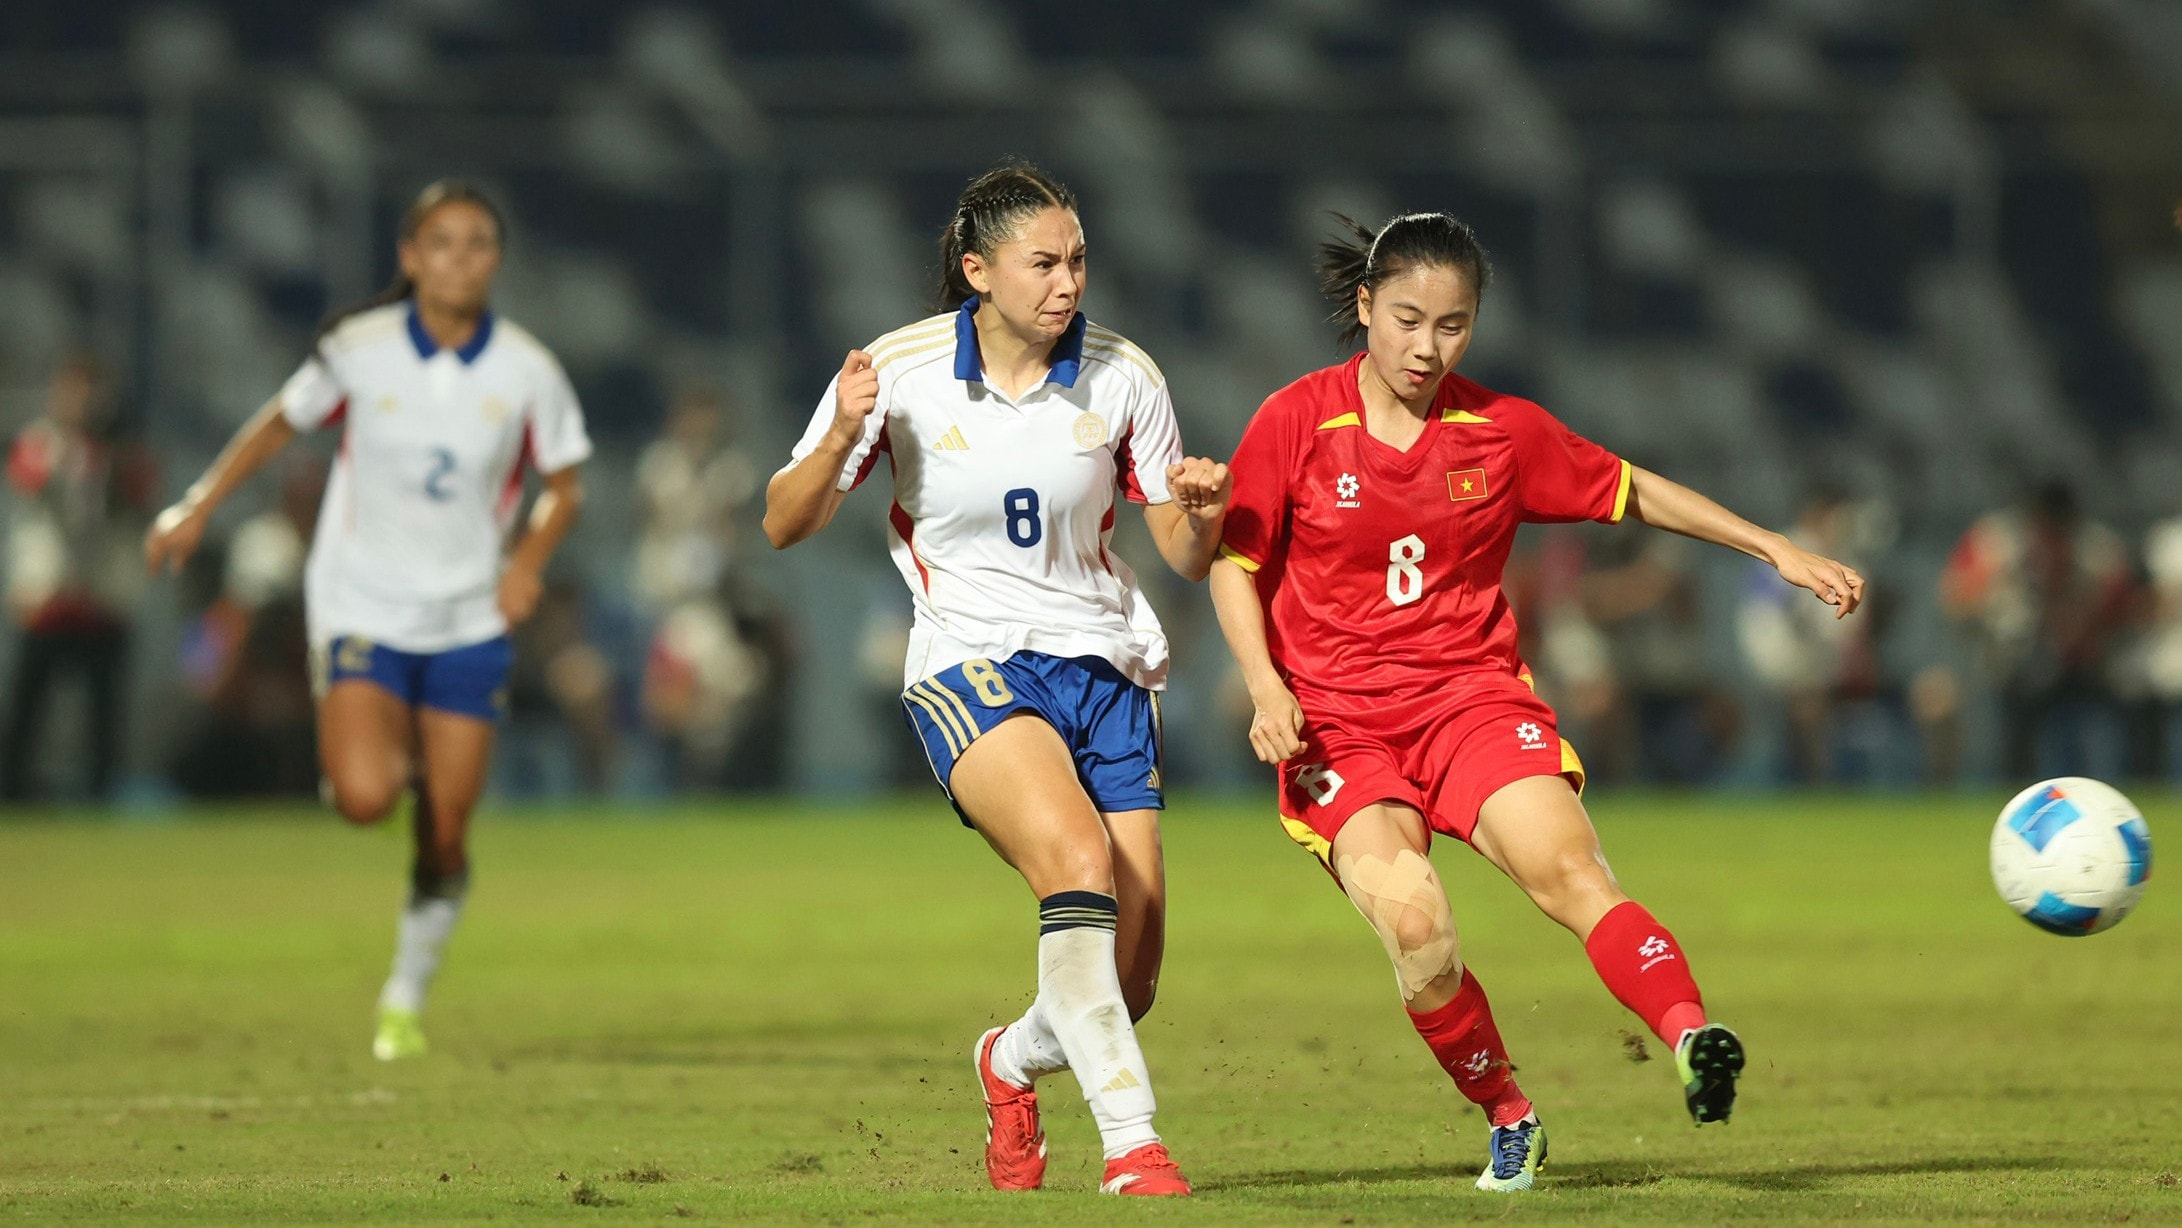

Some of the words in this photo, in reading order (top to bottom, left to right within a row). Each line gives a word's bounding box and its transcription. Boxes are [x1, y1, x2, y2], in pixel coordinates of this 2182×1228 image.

[423, 446, 459, 502] 2
[1004, 488, 1041, 548] 8
[1387, 534, 1425, 606] 8
[962, 659, 1013, 707] 8
[1295, 763, 1345, 807] 8
